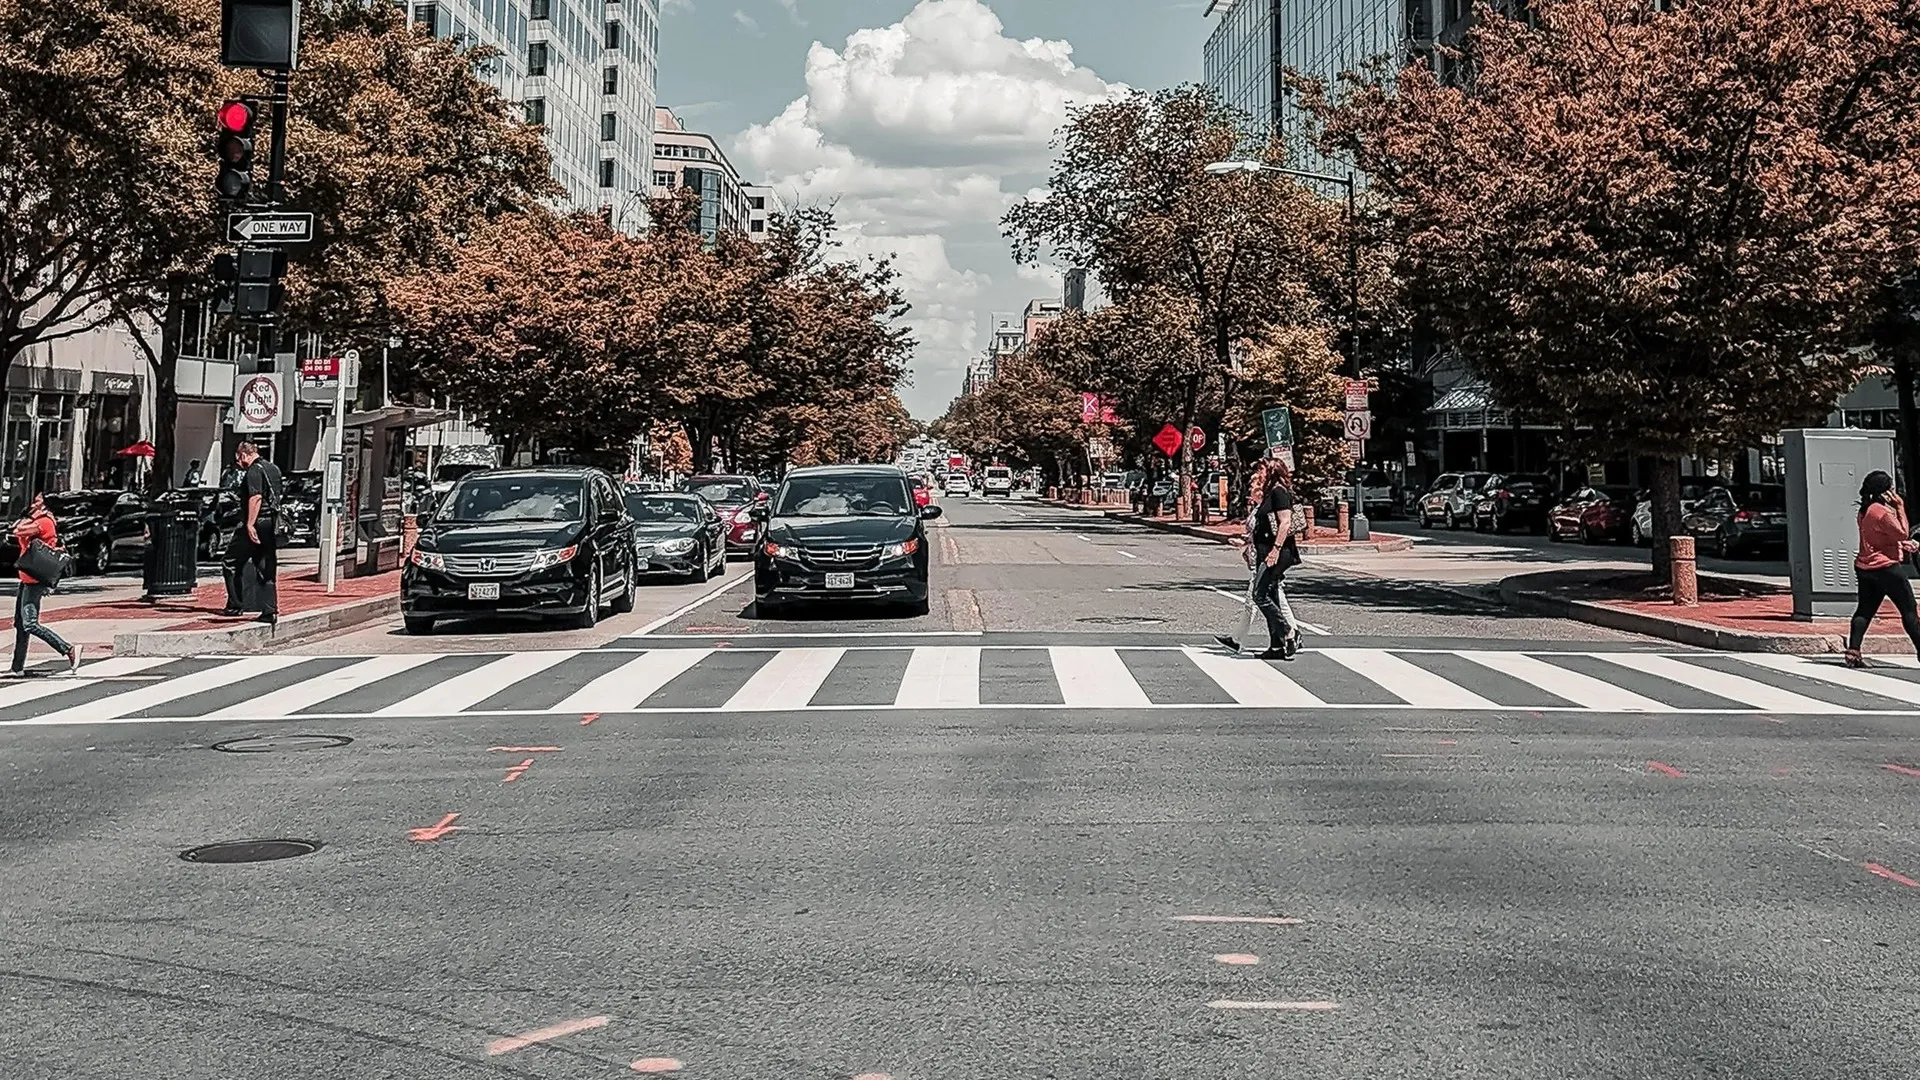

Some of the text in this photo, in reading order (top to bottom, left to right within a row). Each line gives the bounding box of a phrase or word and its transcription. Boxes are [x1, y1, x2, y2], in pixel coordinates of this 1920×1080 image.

[253, 222, 303, 233] ONE WAY
[251, 383, 269, 392] Red
[248, 394, 271, 405] Light
[1084, 397, 1097, 412] K
[239, 407, 277, 416] Running
[1193, 434, 1204, 443] OP
